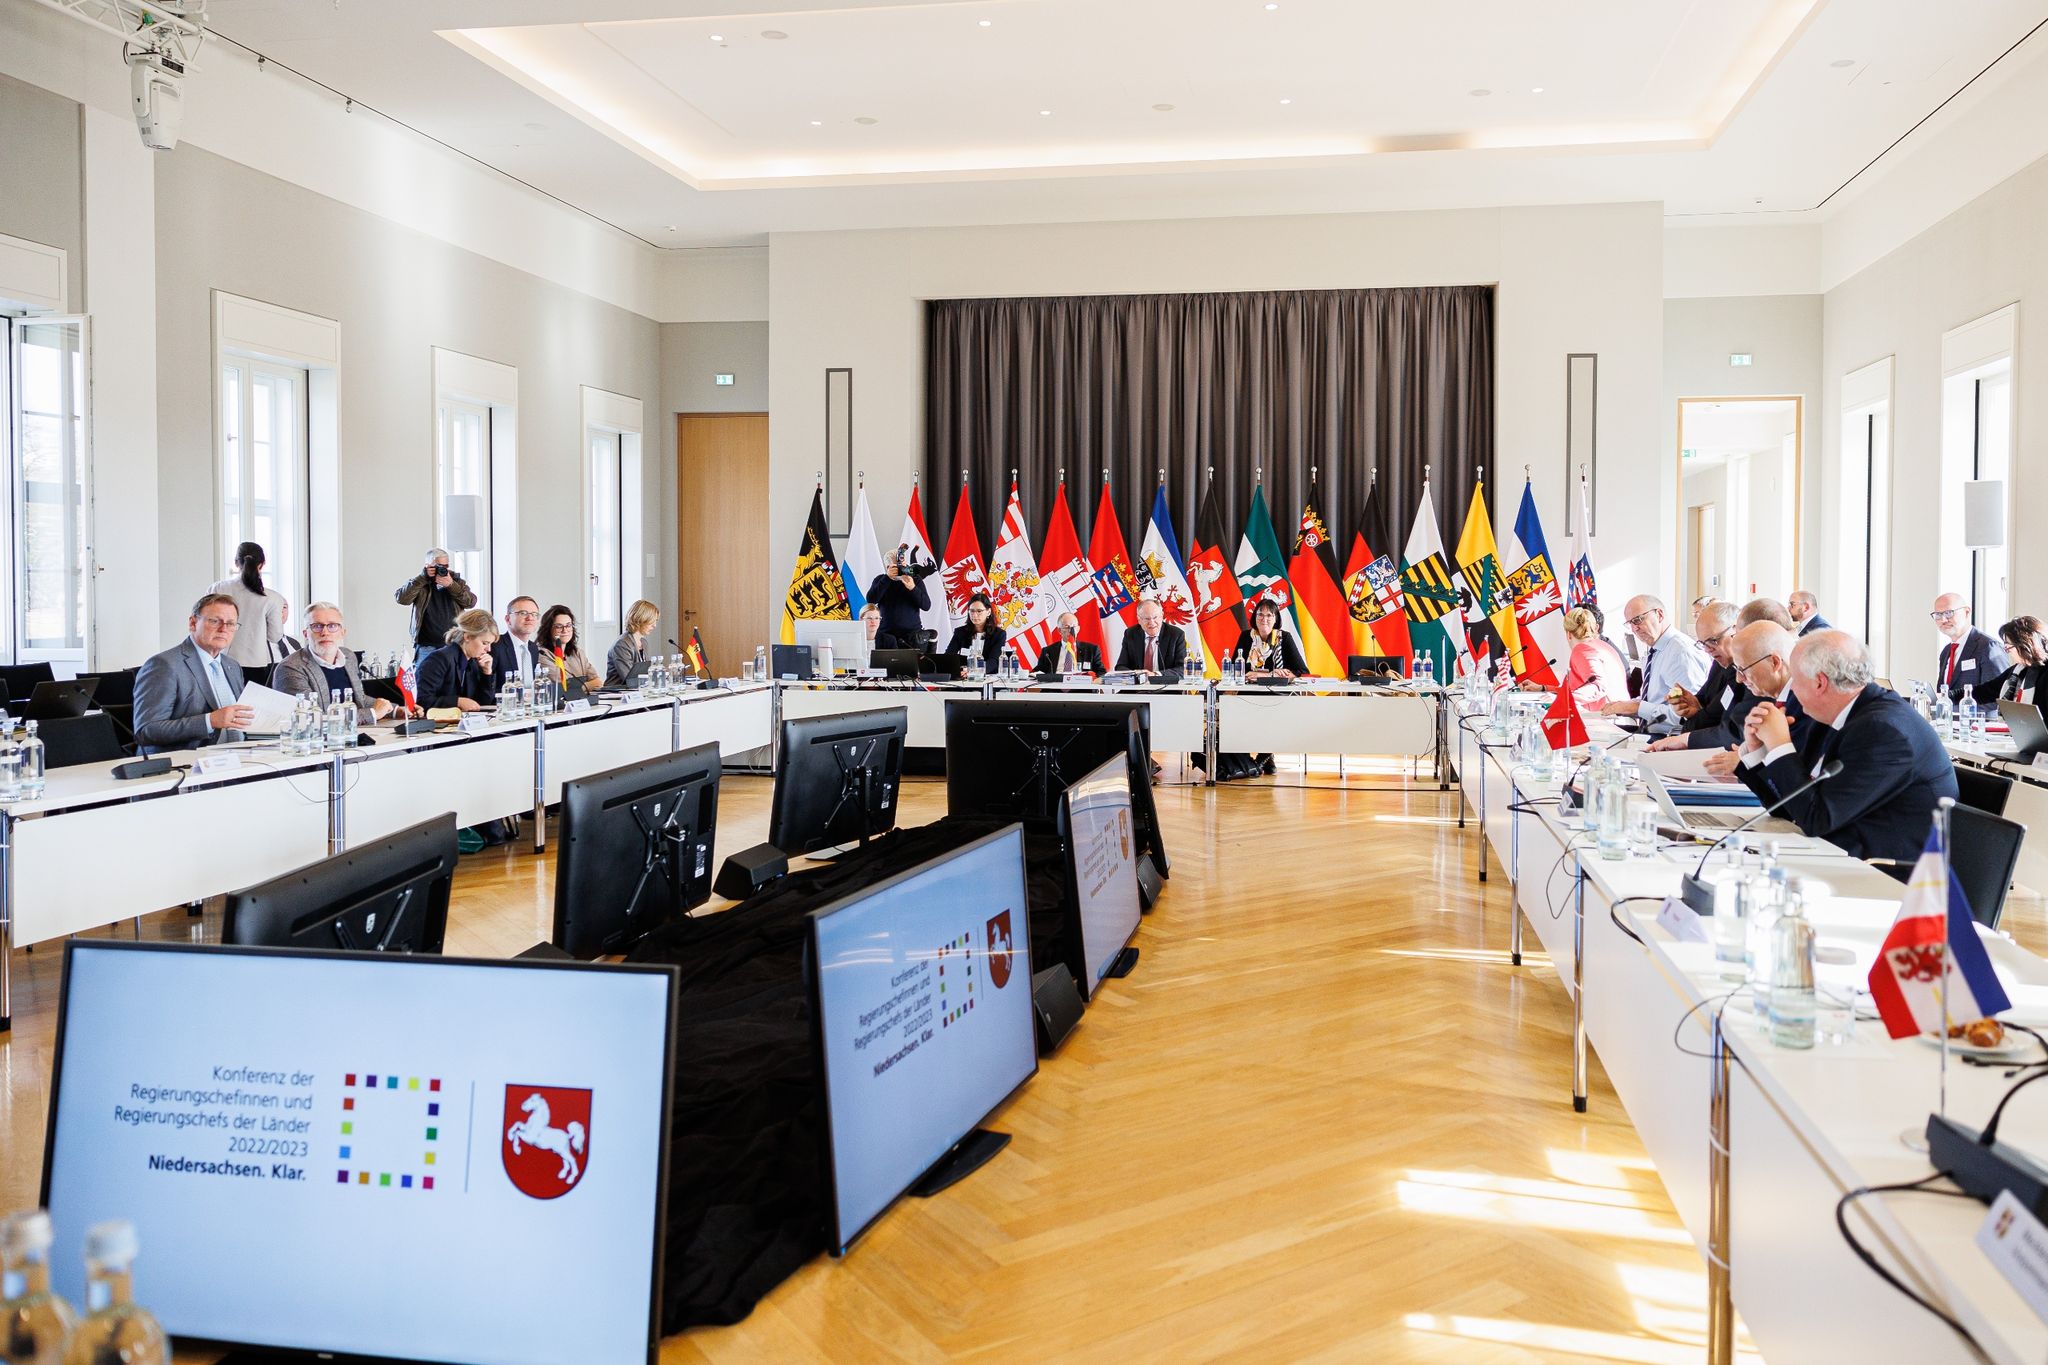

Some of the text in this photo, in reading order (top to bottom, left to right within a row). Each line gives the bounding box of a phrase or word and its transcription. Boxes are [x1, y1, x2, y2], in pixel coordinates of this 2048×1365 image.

[213, 1066, 315, 1087] Konferenz der
[131, 1083, 313, 1110] Regierungschefinnen und
[114, 1105, 311, 1133] Regierungschefs der Länder
[228, 1136, 309, 1157] 2022/2023
[148, 1154, 307, 1181] Niedersachsen. Klar.
